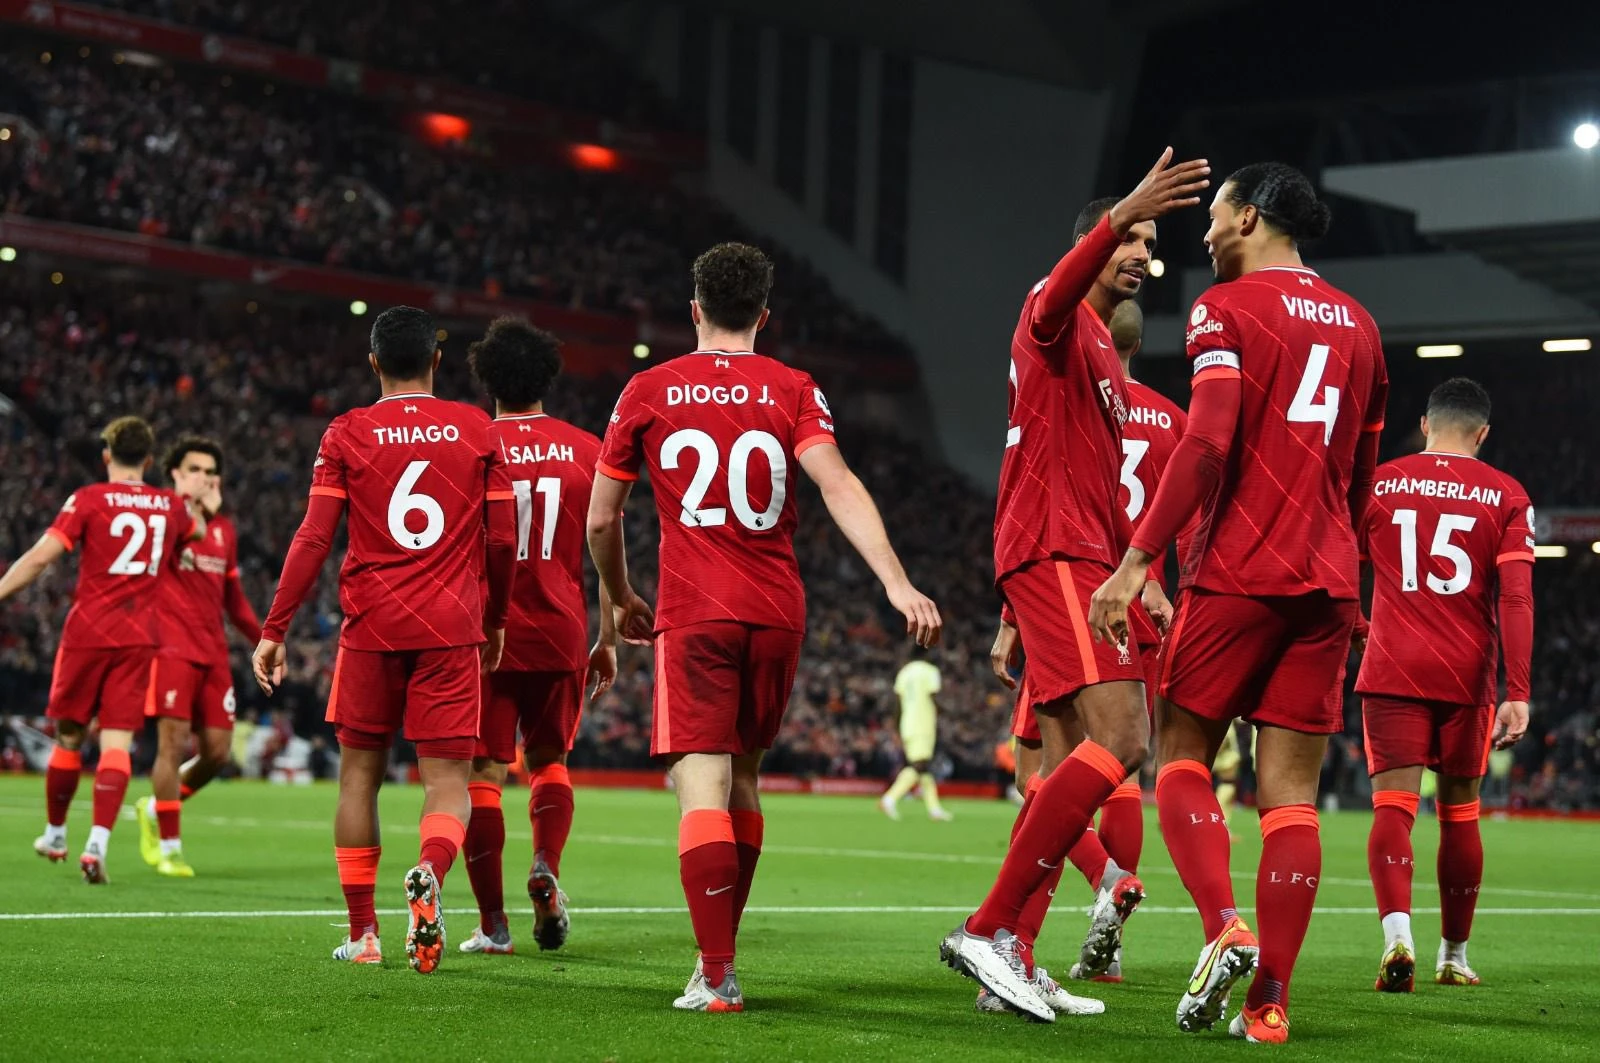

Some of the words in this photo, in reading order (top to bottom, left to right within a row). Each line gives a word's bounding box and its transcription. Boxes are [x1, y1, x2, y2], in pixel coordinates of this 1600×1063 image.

[1280, 294, 1356, 328] VIRGIL
[666, 384, 749, 406] DIOGO
[757, 385, 775, 406] J.
[1286, 343, 1340, 447] 4
[373, 424, 460, 445] THIAGO
[1128, 406, 1172, 429] NHO
[659, 428, 788, 531] 20
[1374, 478, 1502, 507] CHAMBERLAIN
[104, 492, 171, 511] TSIMIKAS
[387, 460, 445, 550] 6
[511, 476, 561, 561] 11
[108, 511, 167, 577] 21
[1391, 508, 1477, 595] 15
[1270, 871, 1318, 888] LFC
